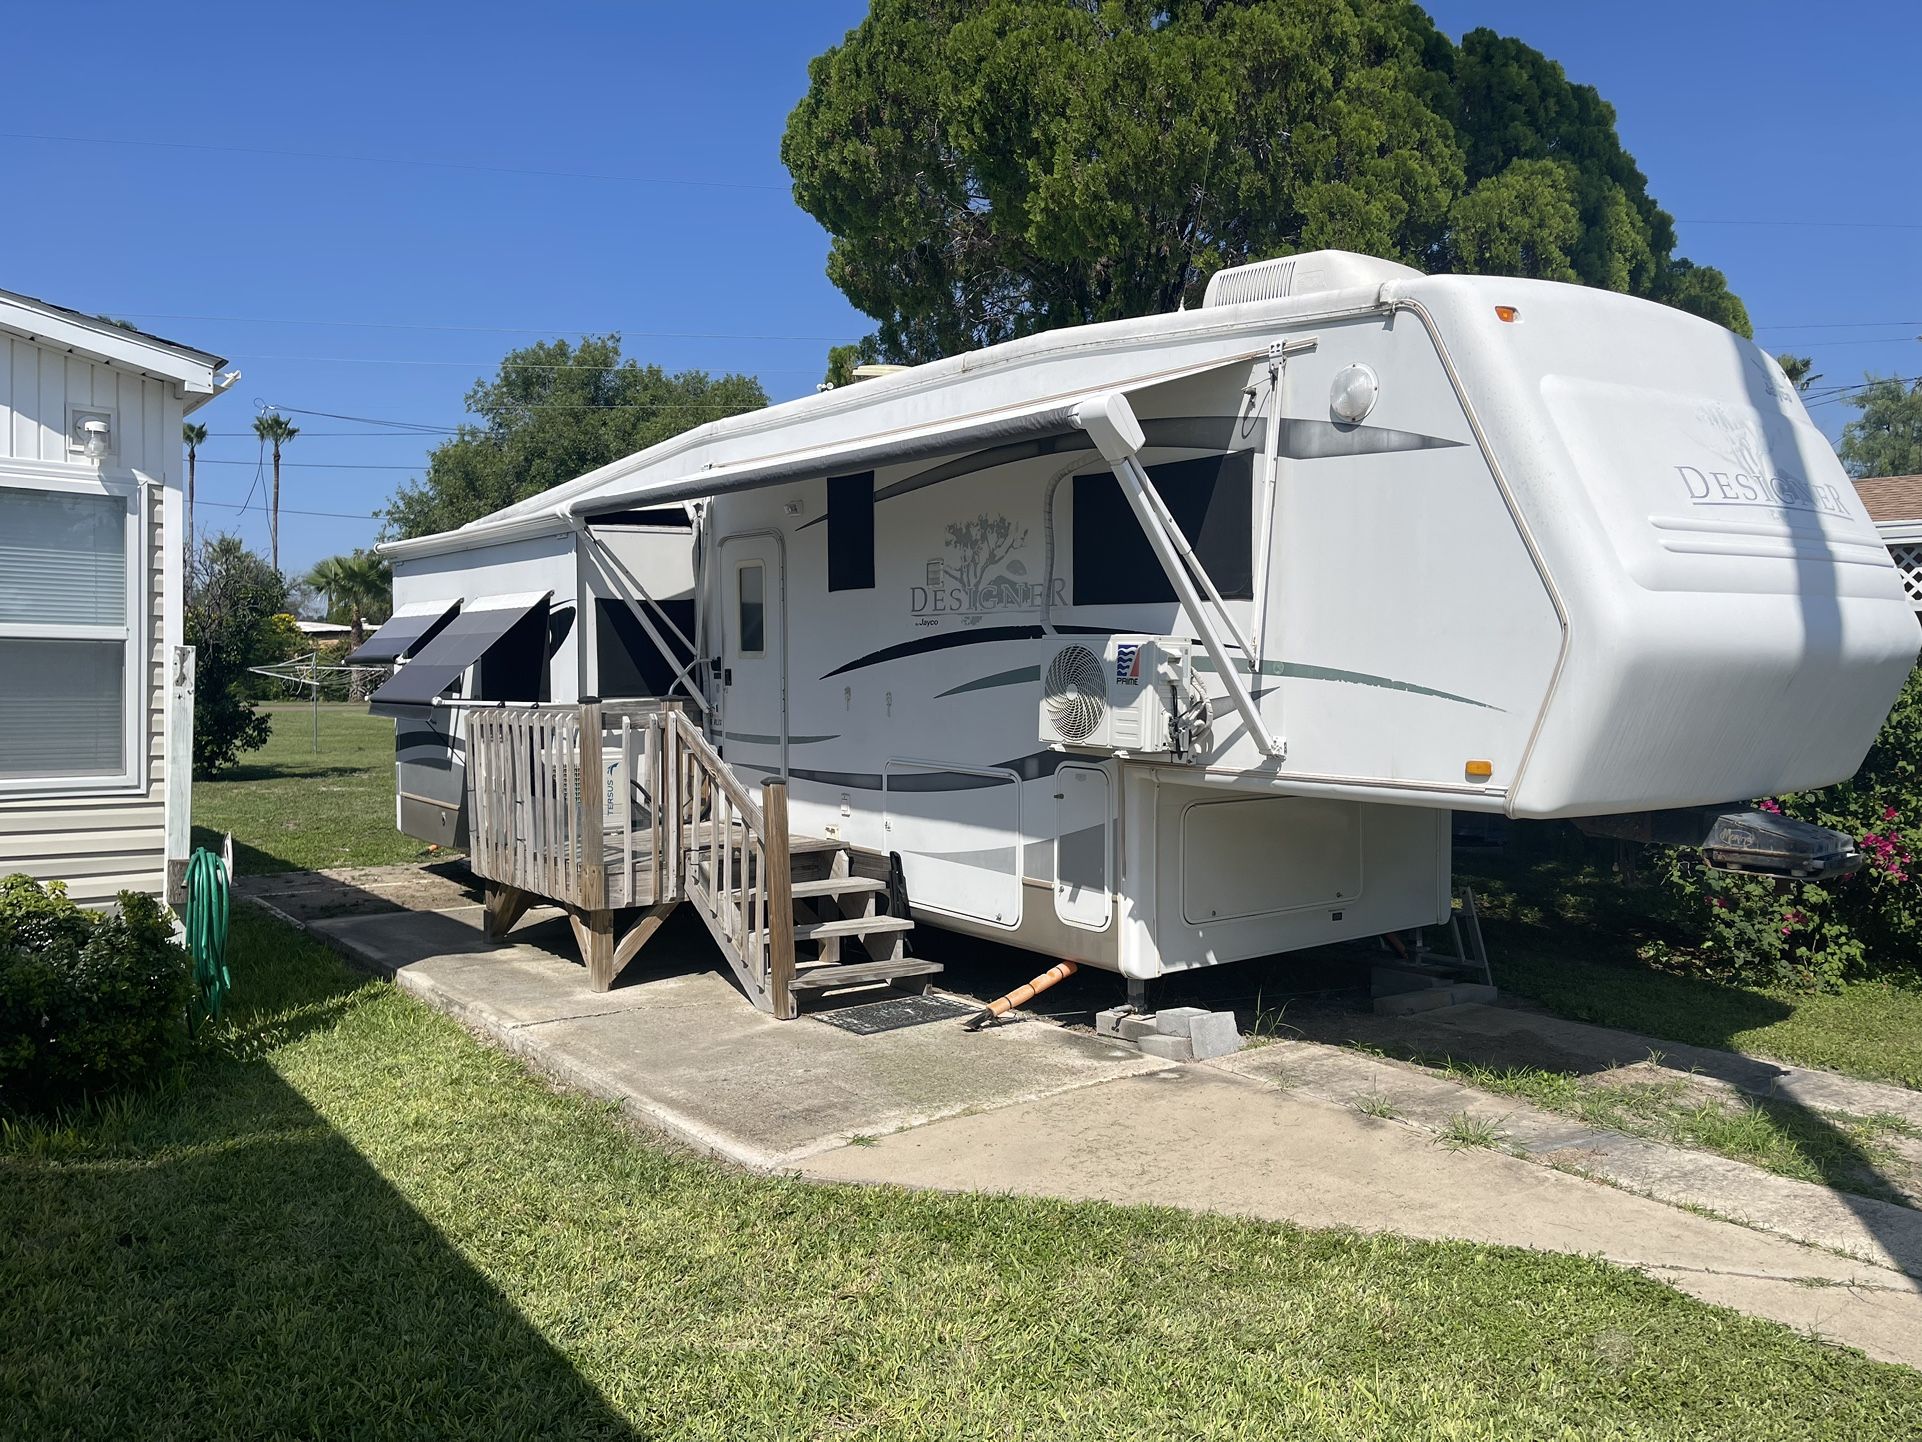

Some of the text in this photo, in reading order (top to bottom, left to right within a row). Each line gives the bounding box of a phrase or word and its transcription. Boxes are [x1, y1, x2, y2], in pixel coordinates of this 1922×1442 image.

[1673, 465, 1852, 515] DESIGNER
[911, 577, 1068, 612] DESIGNER
[919, 618, 939, 627] Jayco
[1116, 677, 1139, 686] PRIME
